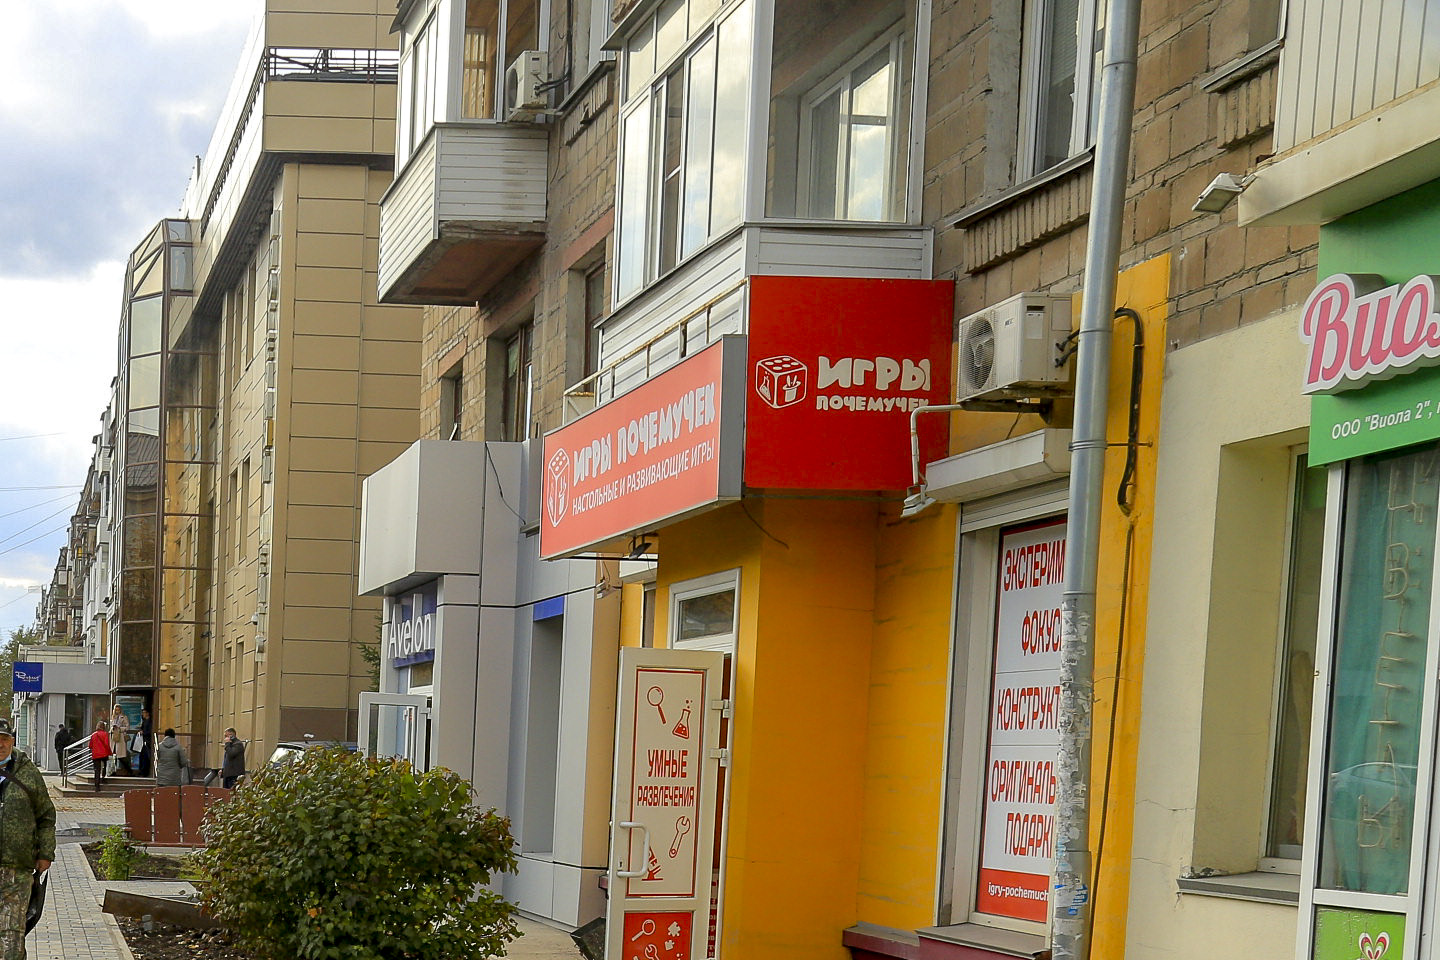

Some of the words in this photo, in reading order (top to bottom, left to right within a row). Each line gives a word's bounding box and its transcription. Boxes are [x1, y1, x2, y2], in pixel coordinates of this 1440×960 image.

[817, 356, 931, 391] ИГРЫ
[816, 395, 930, 412] ПОЧЕМУЧЕК
[1332, 419, 1361, 440] ООО
[1365, 408, 1410, 431] "Виола
[573, 432, 612, 487] ИГРЫ
[617, 382, 716, 465] ПОЧЕМУЧЕК
[572, 486, 619, 516] НАСТОЛЬНЫЕ
[619, 478, 626, 498] И
[626, 449, 690, 494] РАЗВИВАЮЩИЕ
[691, 438, 715, 467] ИГРЫ
[1004, 539, 1066, 592] ЭКСПЕРИМ
[388, 593, 432, 660] Avelon
[1022, 607, 1062, 656] ФОКУС
[996, 686, 1061, 731] КОНСТРУКТ
[648, 749, 688, 778] УМНЫЕ
[991, 760, 1056, 804] ОРИГИНАЛЬ
[637, 785, 695, 807] РАЗВЛЕЧЕНИЯ
[988, 882, 1050, 902] igry-pochemuch
